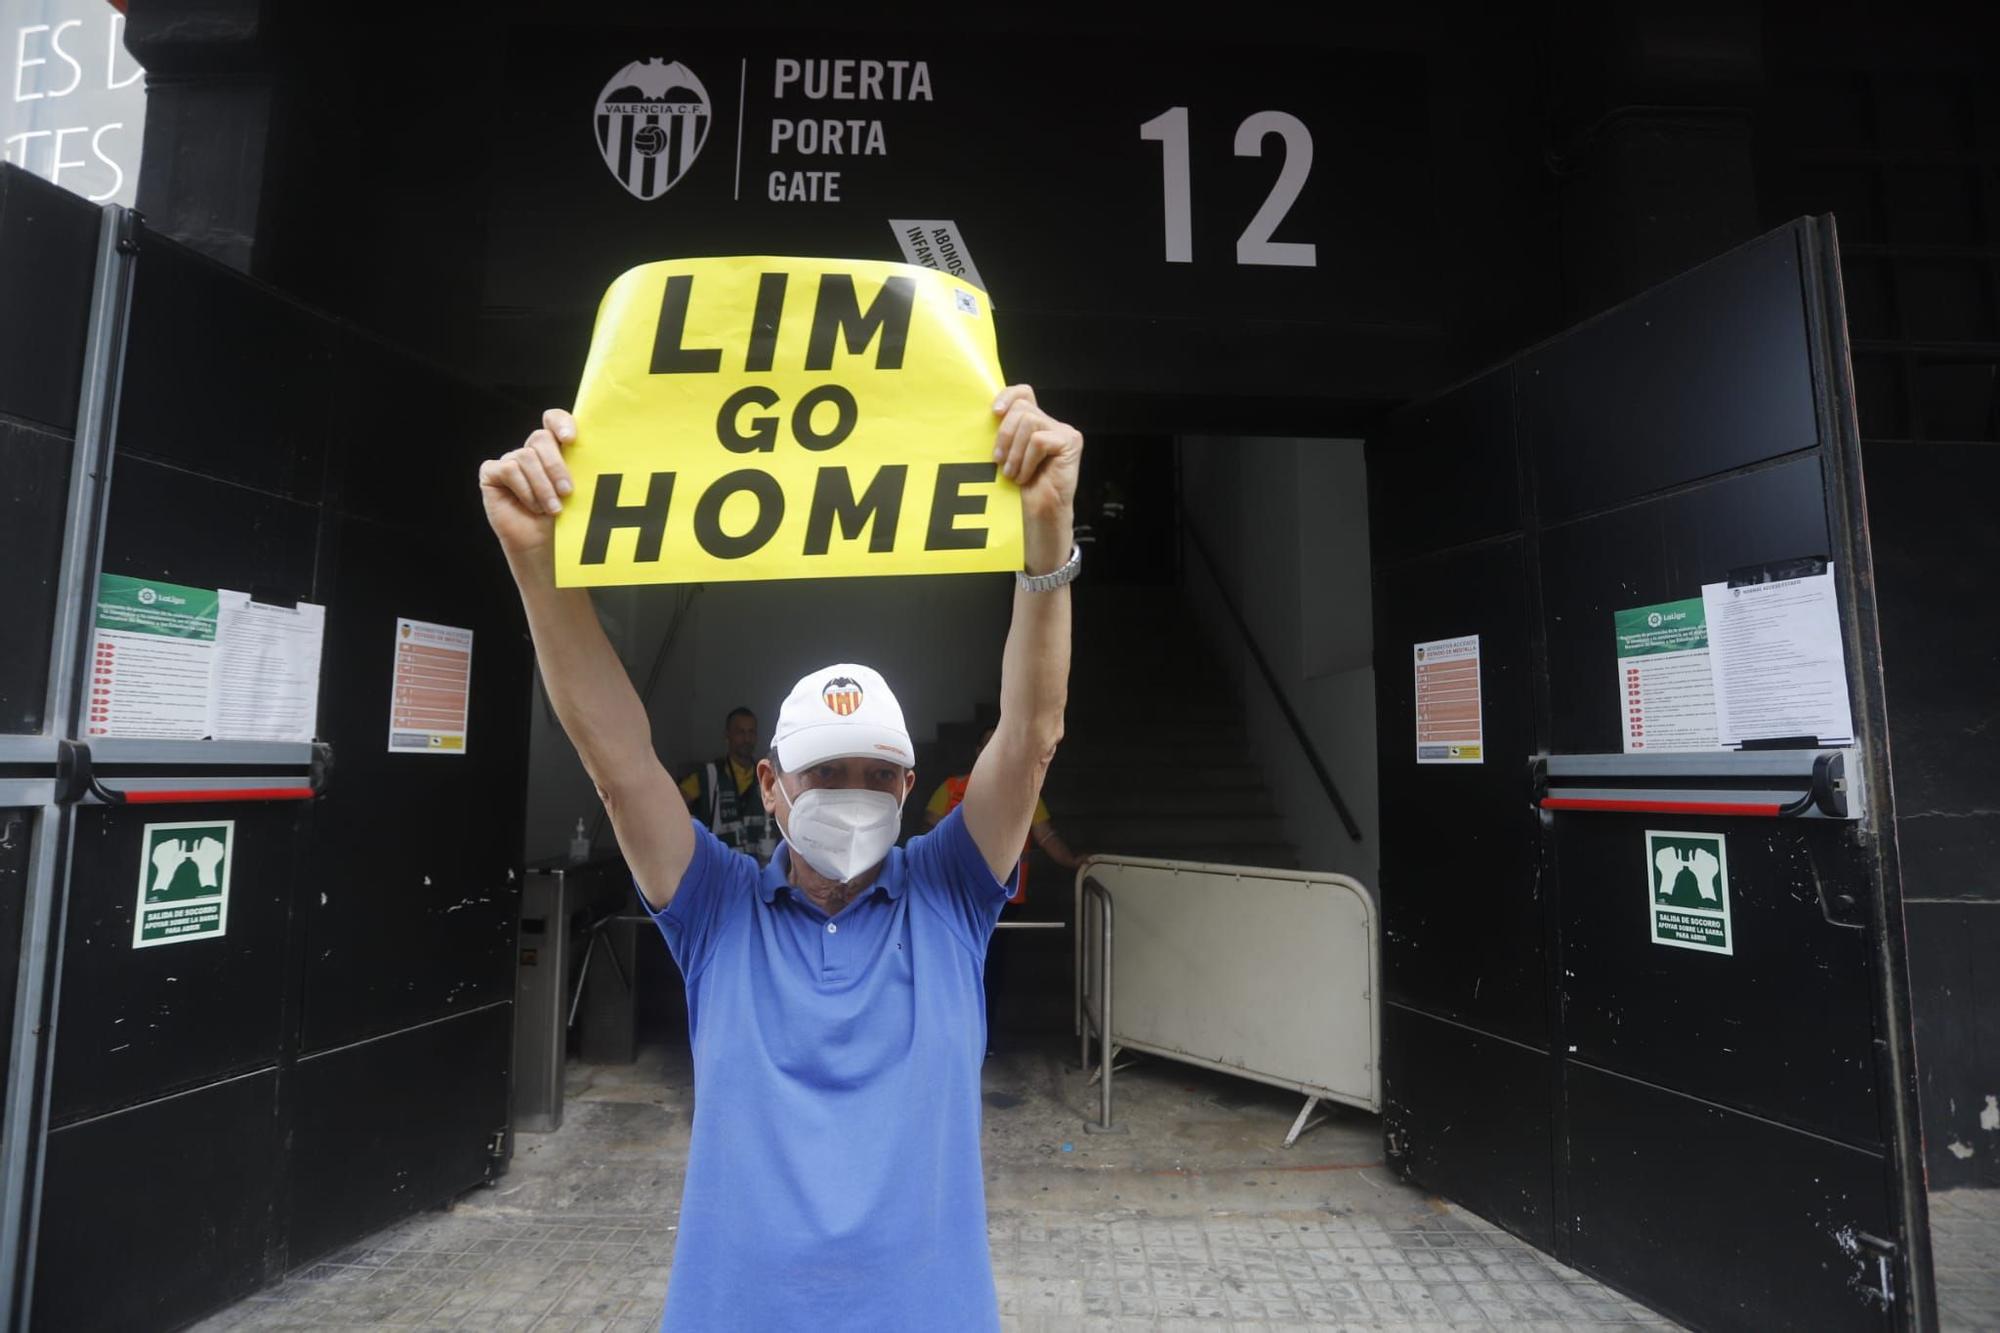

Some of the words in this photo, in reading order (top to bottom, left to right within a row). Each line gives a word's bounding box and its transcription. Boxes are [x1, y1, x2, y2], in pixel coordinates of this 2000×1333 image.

[774, 58, 934, 101] PUERTA
[605, 104, 673, 114] VALENCIA
[677, 104, 703, 115] C.F.
[770, 118, 888, 156] PORTA
[768, 170, 841, 203] GATE
[1140, 106, 1317, 267] 12
[906, 226, 940, 270] INFANT
[931, 228, 966, 277] ABONOS
[649, 272, 917, 374] LIM
[716, 384, 858, 454] GO
[579, 462, 999, 566] HOME
[1663, 612, 1686, 621] LaLiga
[147, 911, 173, 921] SALIDA
[174, 909, 184, 917] DE
[184, 906, 218, 916] SOCORRO
[1658, 922, 1678, 930] APOYAR
[1679, 924, 1696, 932] SOBRE
[1705, 927, 1724, 936] BARRA
[1659, 914, 1681, 923] SALIDA
[1681, 916, 1690, 924] DE
[1690, 917, 1721, 928] SOCORRO
[1675, 931, 1690, 939] PARA
[1690, 933, 1707, 942] ABRIR
